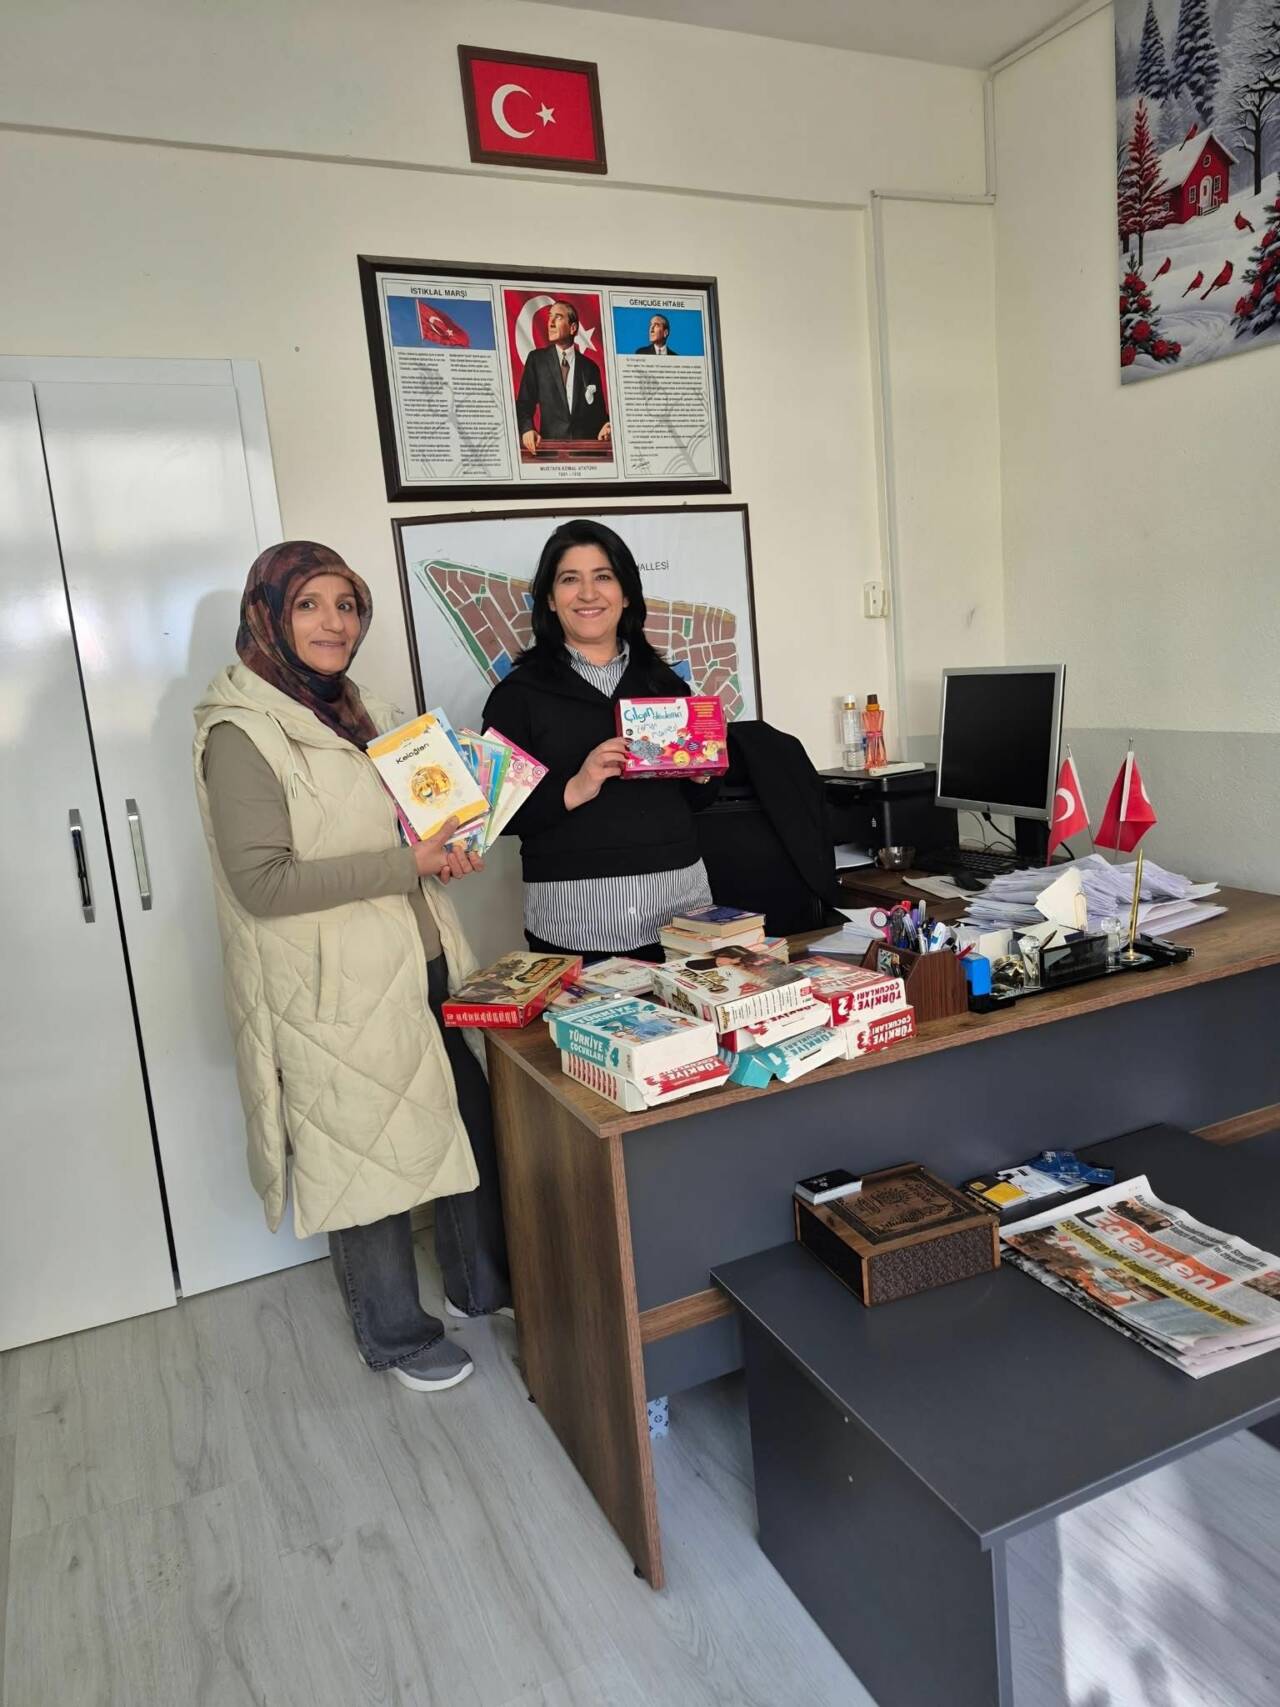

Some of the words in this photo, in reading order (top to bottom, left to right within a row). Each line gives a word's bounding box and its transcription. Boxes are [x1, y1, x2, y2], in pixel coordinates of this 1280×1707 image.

[396, 742, 430, 765] Keloğlan
[856, 989, 902, 1011] TÜRKİYE
[568, 1029, 603, 1051] TÜRKİYE
[789, 1031, 834, 1058] TÜRKİYE
[873, 1024, 913, 1045] TÜRKİYE
[570, 1042, 604, 1062] ÇOCUKLARI
[1085, 1211, 1217, 1291] Egemen
